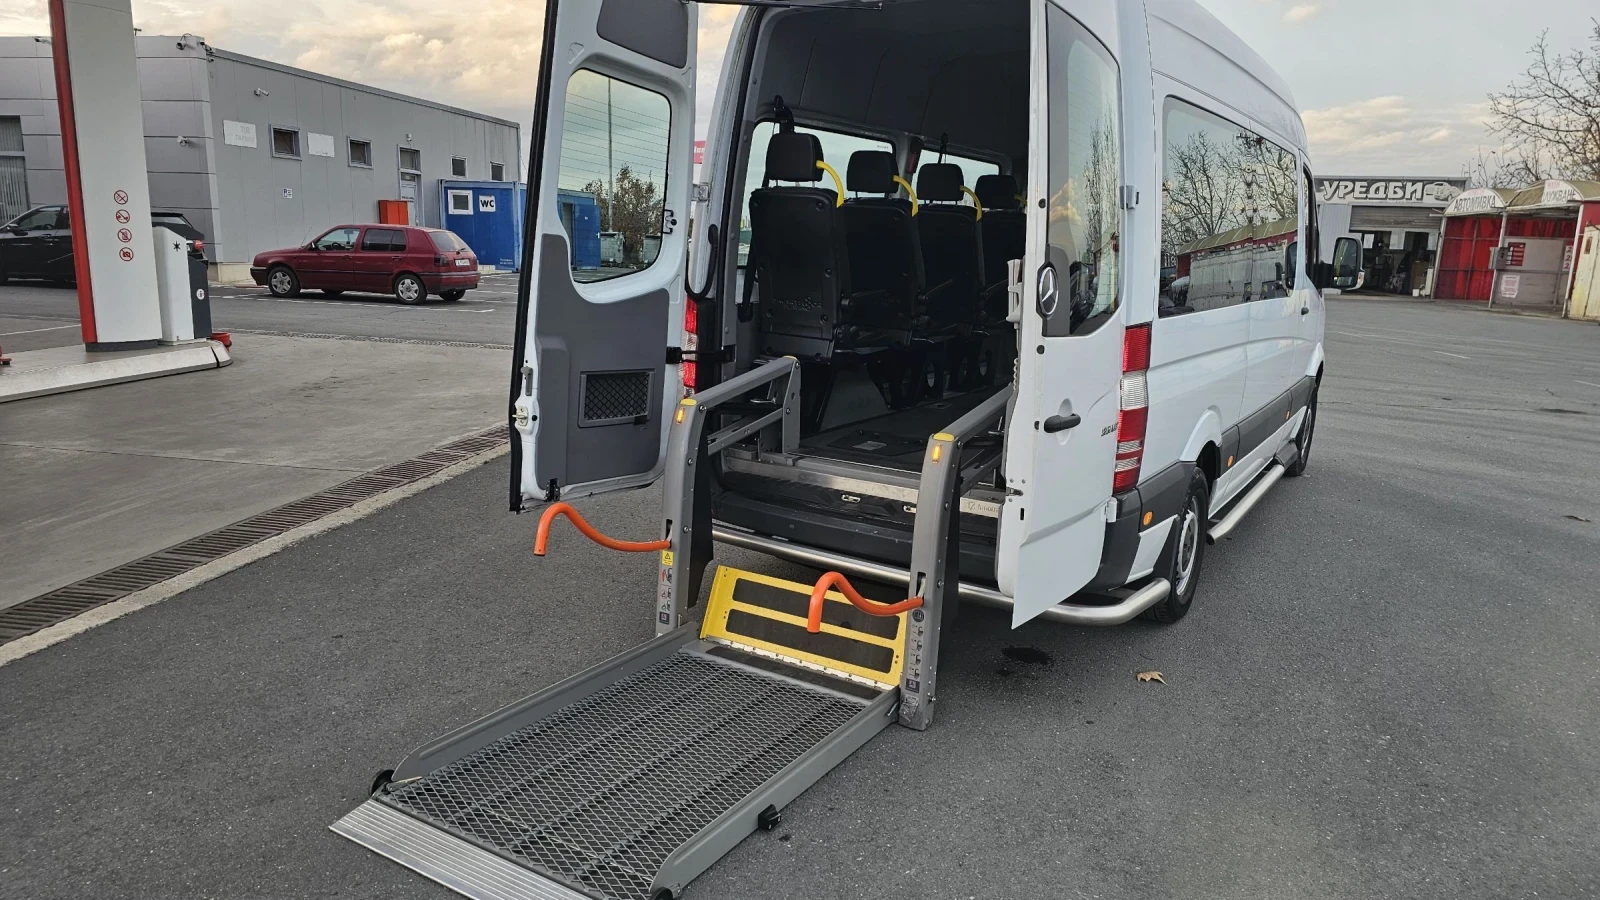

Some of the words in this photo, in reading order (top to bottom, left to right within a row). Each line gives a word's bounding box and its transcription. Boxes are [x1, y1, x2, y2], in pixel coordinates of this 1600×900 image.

[1323, 180, 1424, 201] УРЕДБИ
[480, 199, 495, 208] WC
[1453, 195, 1496, 212] АВТОМИВКА
